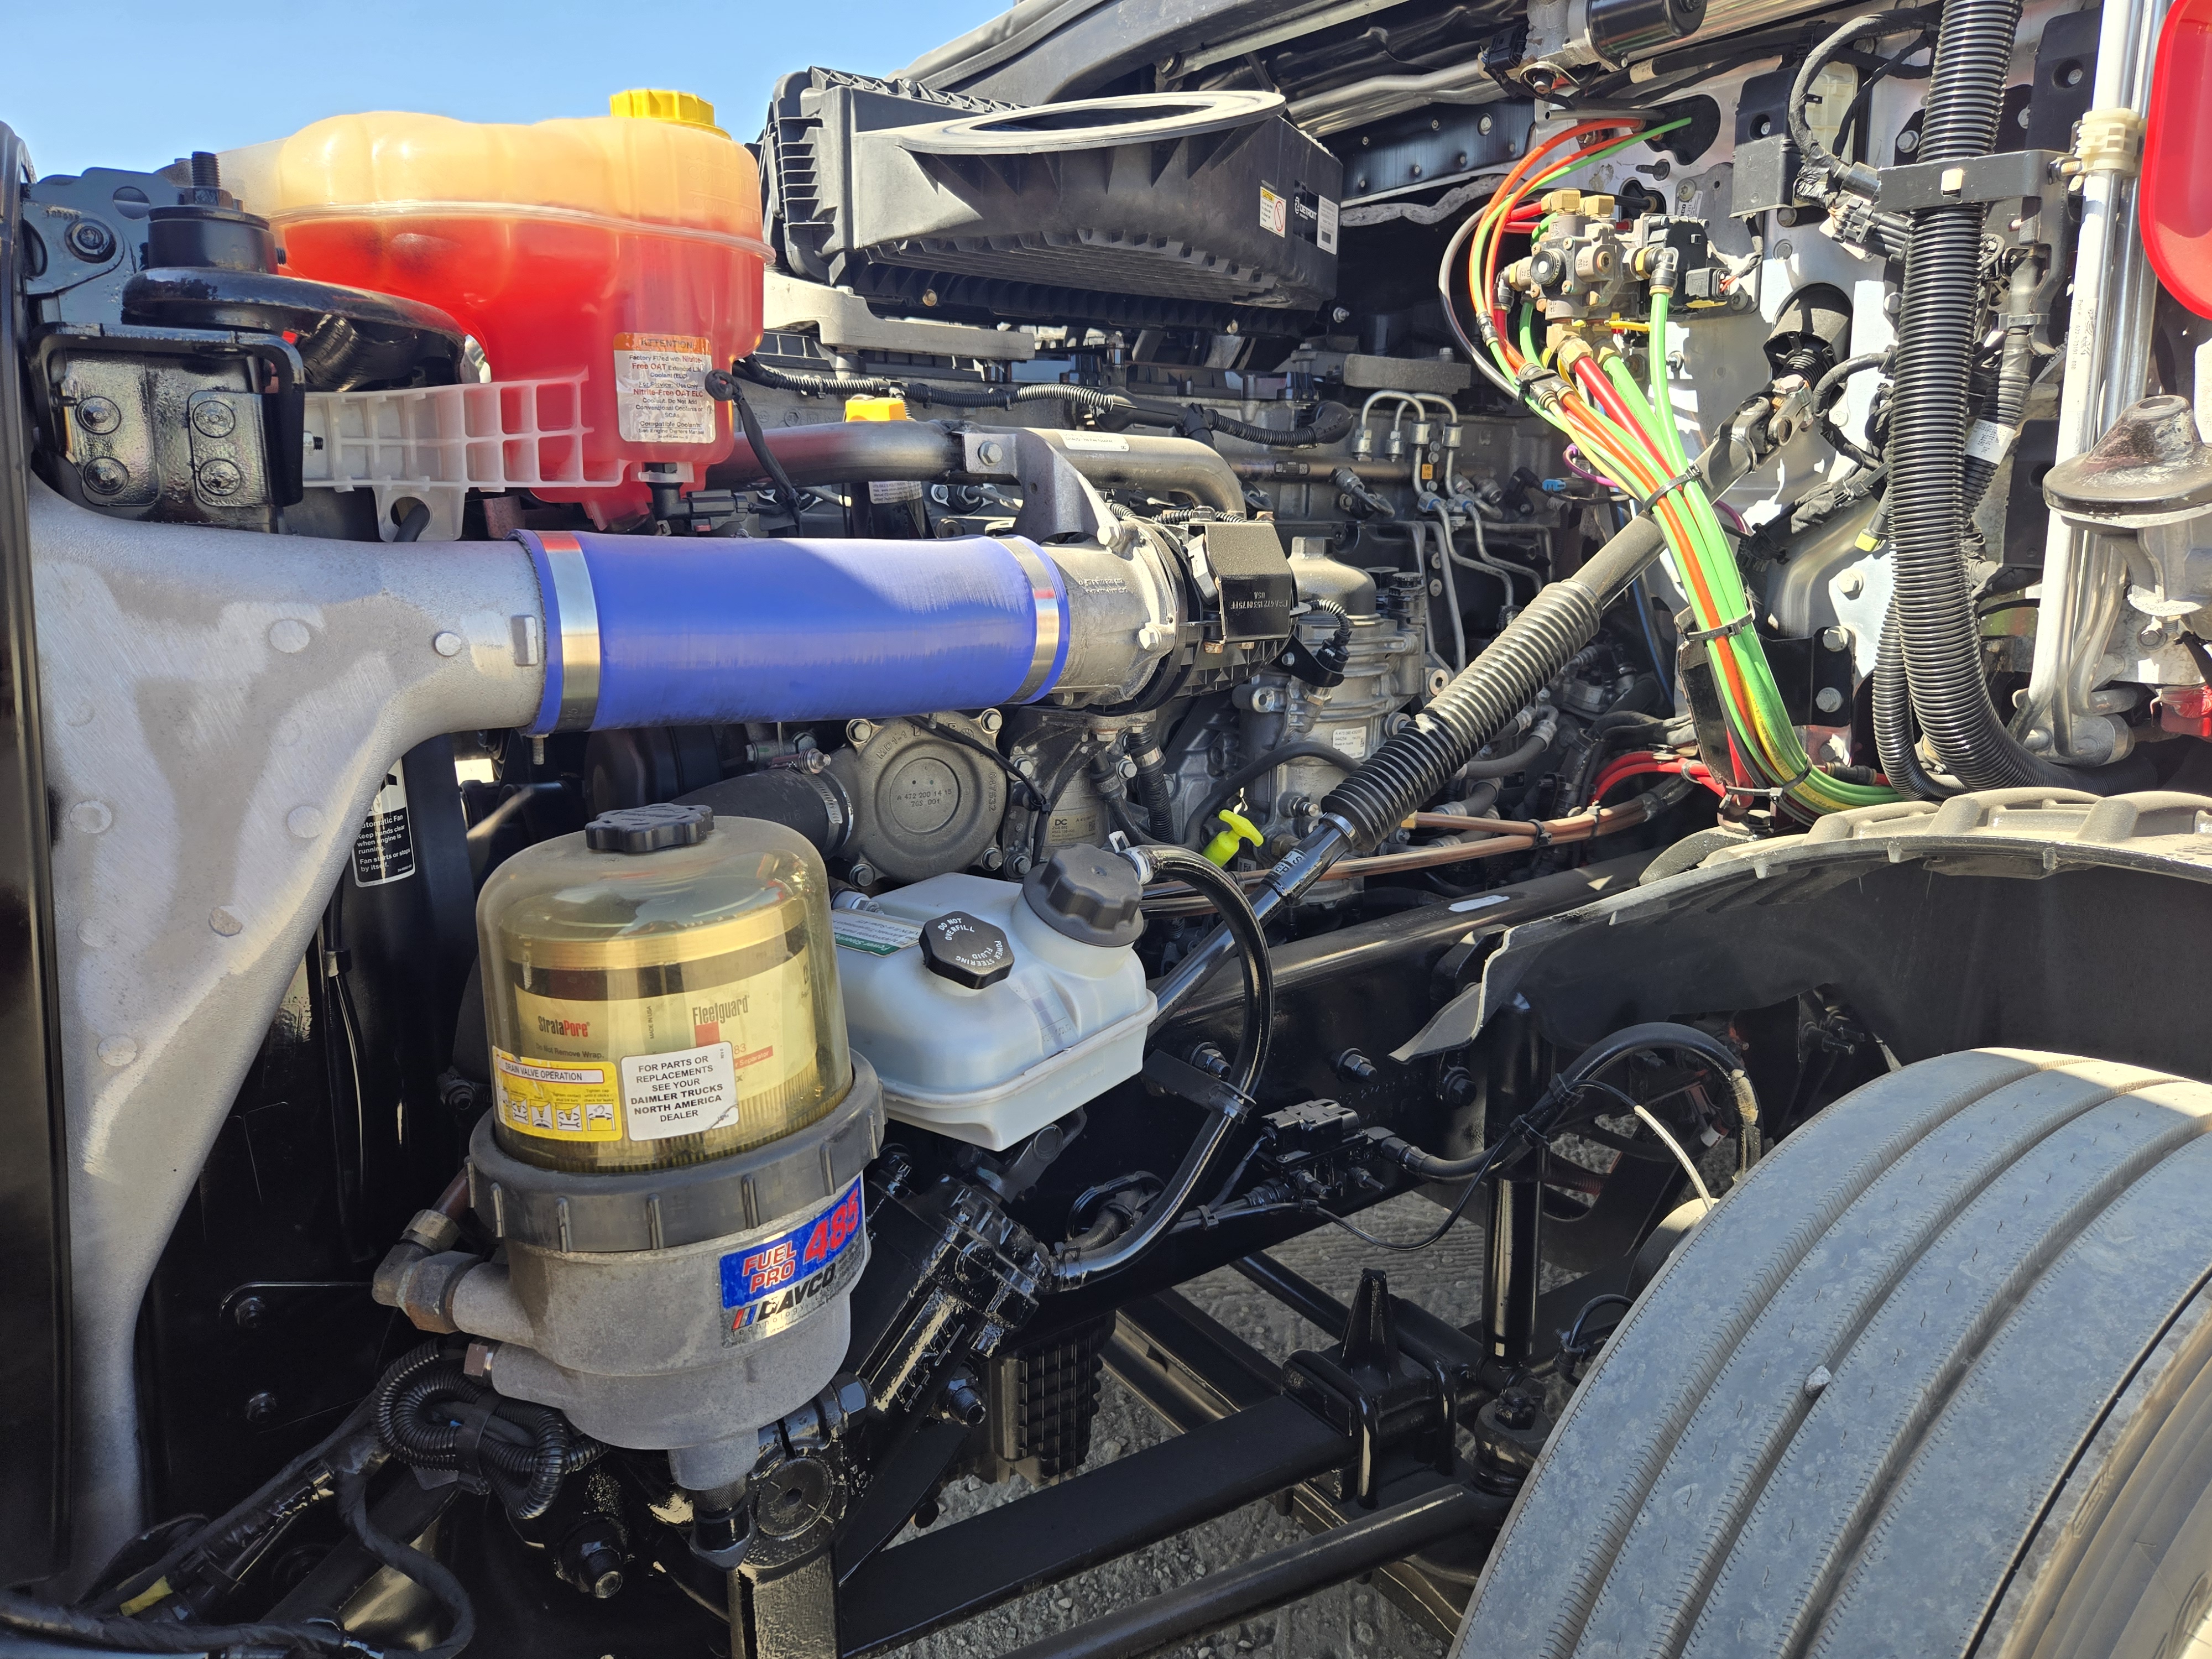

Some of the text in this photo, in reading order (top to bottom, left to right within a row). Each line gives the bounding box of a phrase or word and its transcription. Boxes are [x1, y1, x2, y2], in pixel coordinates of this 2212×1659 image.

[1300, 203, 1317, 220] DETROIT
[641, 338, 693, 349] ATTENTION
[911, 798, 940, 808] ZGS 001
[919, 791, 931, 799] 200
[362, 814, 403, 829] utomatic Fan
[358, 846, 386, 855] running.
[373, 853, 393, 863] starts
[399, 848, 411, 857] stops
[937, 922, 948, 931] DO
[945, 925, 975, 941] OVERFILL
[864, 942, 891, 951] Power
[955, 940, 1004, 967] POWER STEERING
[972, 947, 994, 960] FLUID
[692, 995, 749, 1026] Fleetguard
[544, 1045, 554, 1053] Not
[554, 1047, 581, 1057] Remove
[582, 1051, 605, 1060] Wrap.
[739, 1050, 770, 1067] Separator
[505, 1062, 583, 1081] DRAIN VALVE OPERATION
[638, 1055, 709, 1073] FOR PARTS OR
[636, 1065, 714, 1084] REPLACEMENTS
[651, 1078, 701, 1092] SEE YOUR
[630, 1083, 724, 1105] DAIMLER TRUCKS
[634, 1094, 722, 1115] NORTH AMERICA
[660, 1109, 699, 1123] DEALER
[803, 1187, 859, 1265] 485
[742, 1240, 797, 1277] FUEL
[749, 1259, 796, 1293] PRO
